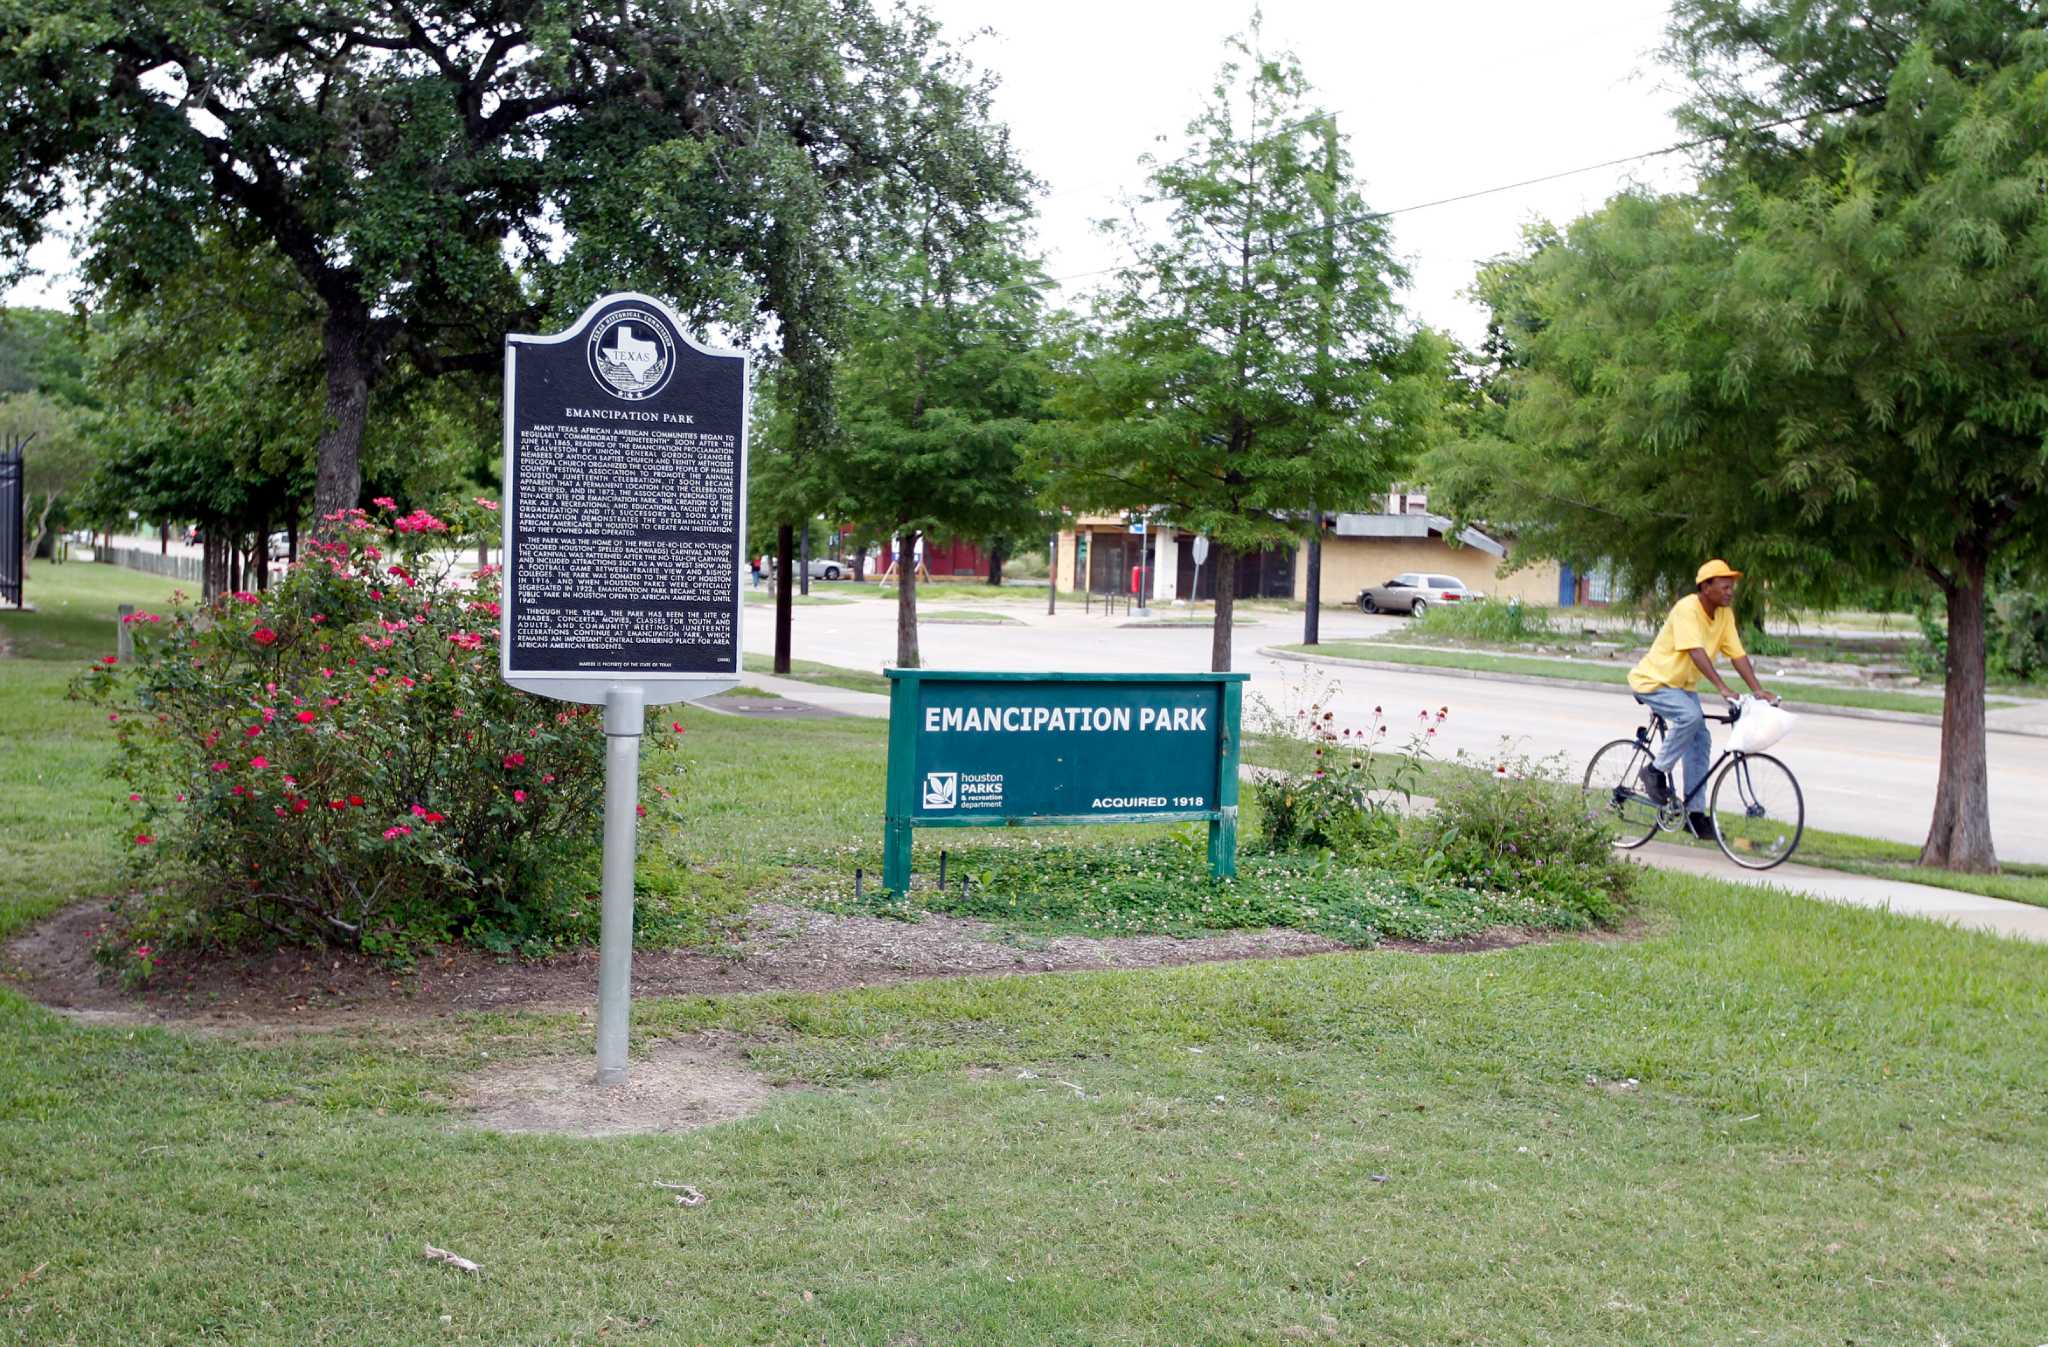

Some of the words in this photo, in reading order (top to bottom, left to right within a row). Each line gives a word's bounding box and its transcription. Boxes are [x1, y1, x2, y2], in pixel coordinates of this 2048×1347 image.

[613, 351, 650, 361] TEXAS
[565, 407, 659, 421] EMANCIPATION
[663, 413, 695, 424] PARK
[563, 433, 617, 441] COMMEMORATE
[925, 707, 1130, 732] EMANCIPATION
[1139, 707, 1207, 731] PARK
[961, 772, 1004, 783] houston
[961, 783, 1003, 793] PARKS
[968, 794, 1003, 802] recreation
[1092, 797, 1168, 808] ACQUIRED
[1172, 797, 1205, 807] 1918
[960, 801, 1002, 809] department
